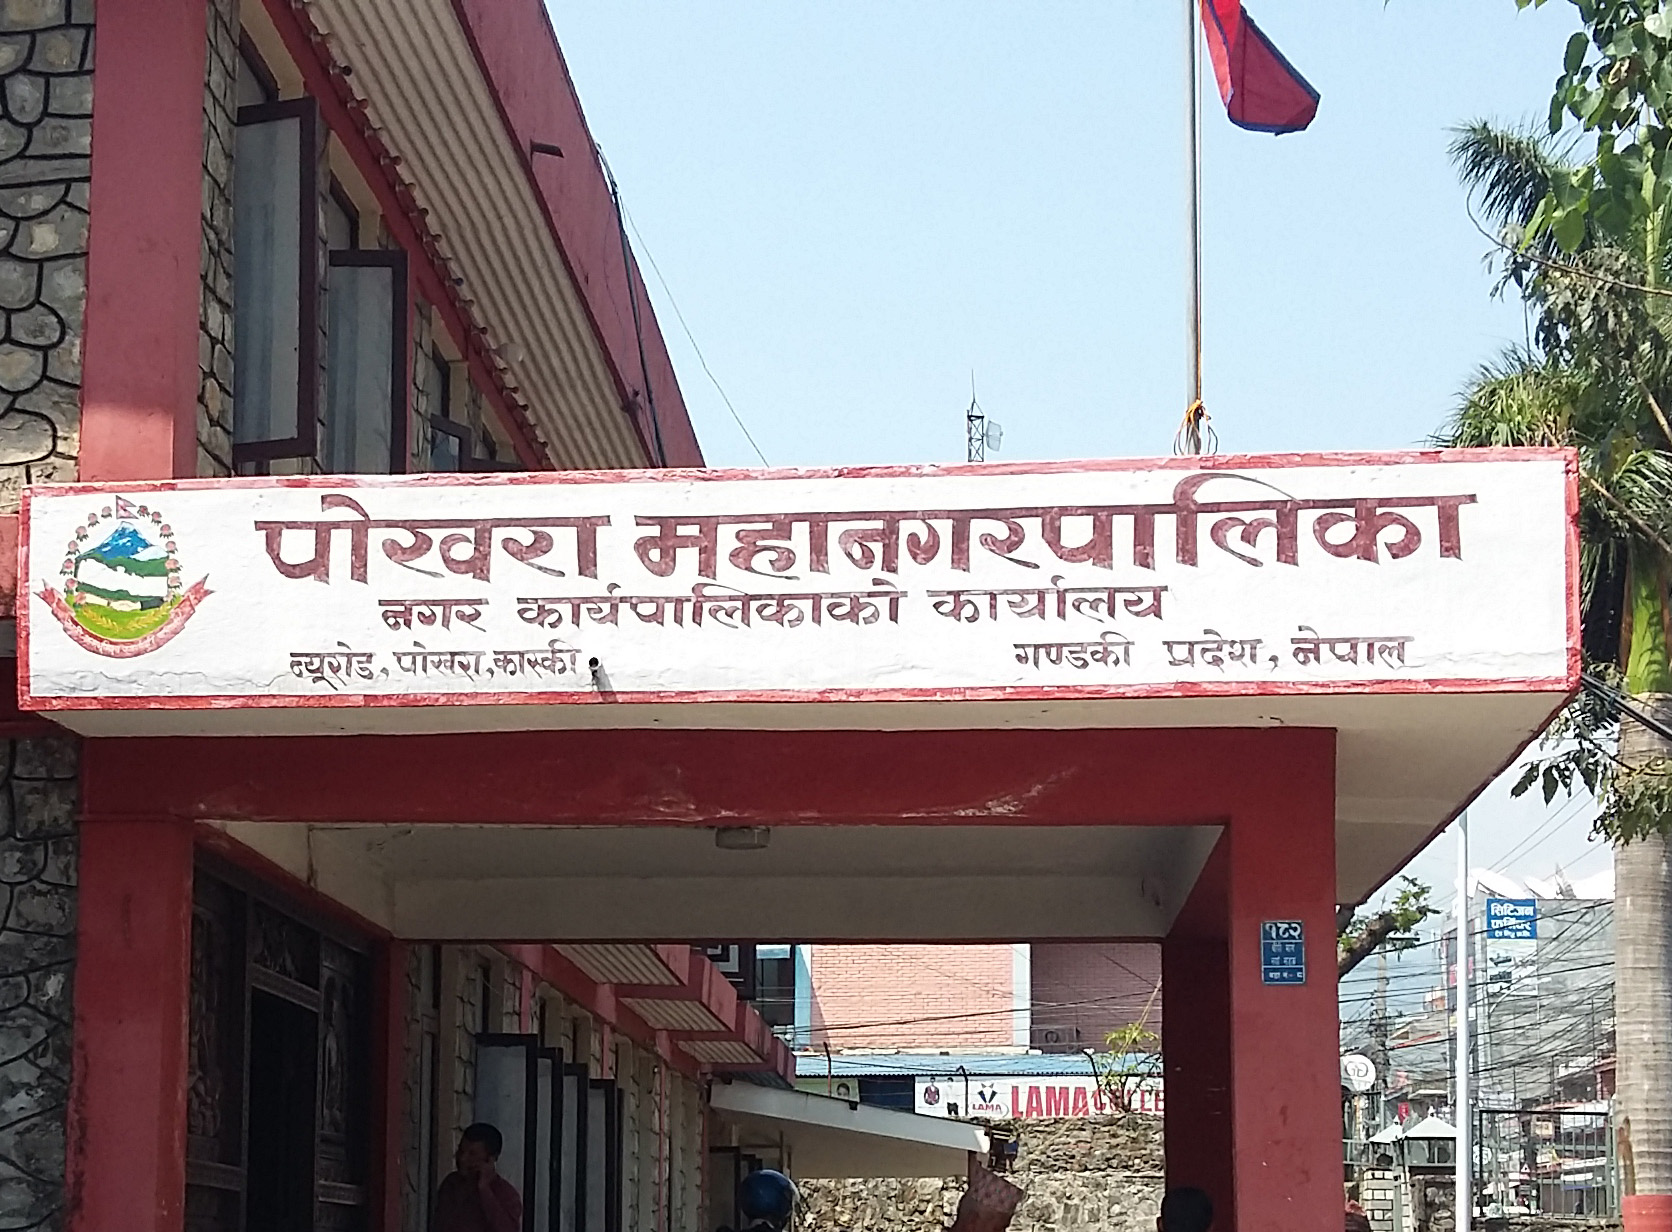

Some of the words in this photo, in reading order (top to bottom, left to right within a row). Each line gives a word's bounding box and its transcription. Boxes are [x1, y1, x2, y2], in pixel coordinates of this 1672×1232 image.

[254, 494, 611, 585] पोखरा
[634, 473, 1477, 581] महानगरपालिका
[378, 598, 489, 632] नगर
[516, 578, 908, 629] कार्यपालिकाको
[926, 575, 1169, 624] कार्यालय
[1013, 631, 1135, 670] गण्डकी
[1162, 629, 1279, 674] प्रदेश,
[1291, 626, 1415, 670] नेपाल
[1265, 922, 1301, 940] १८२
[972, 1103, 1002, 1112] LAMA
[1011, 1085, 1090, 1119] LAMA
